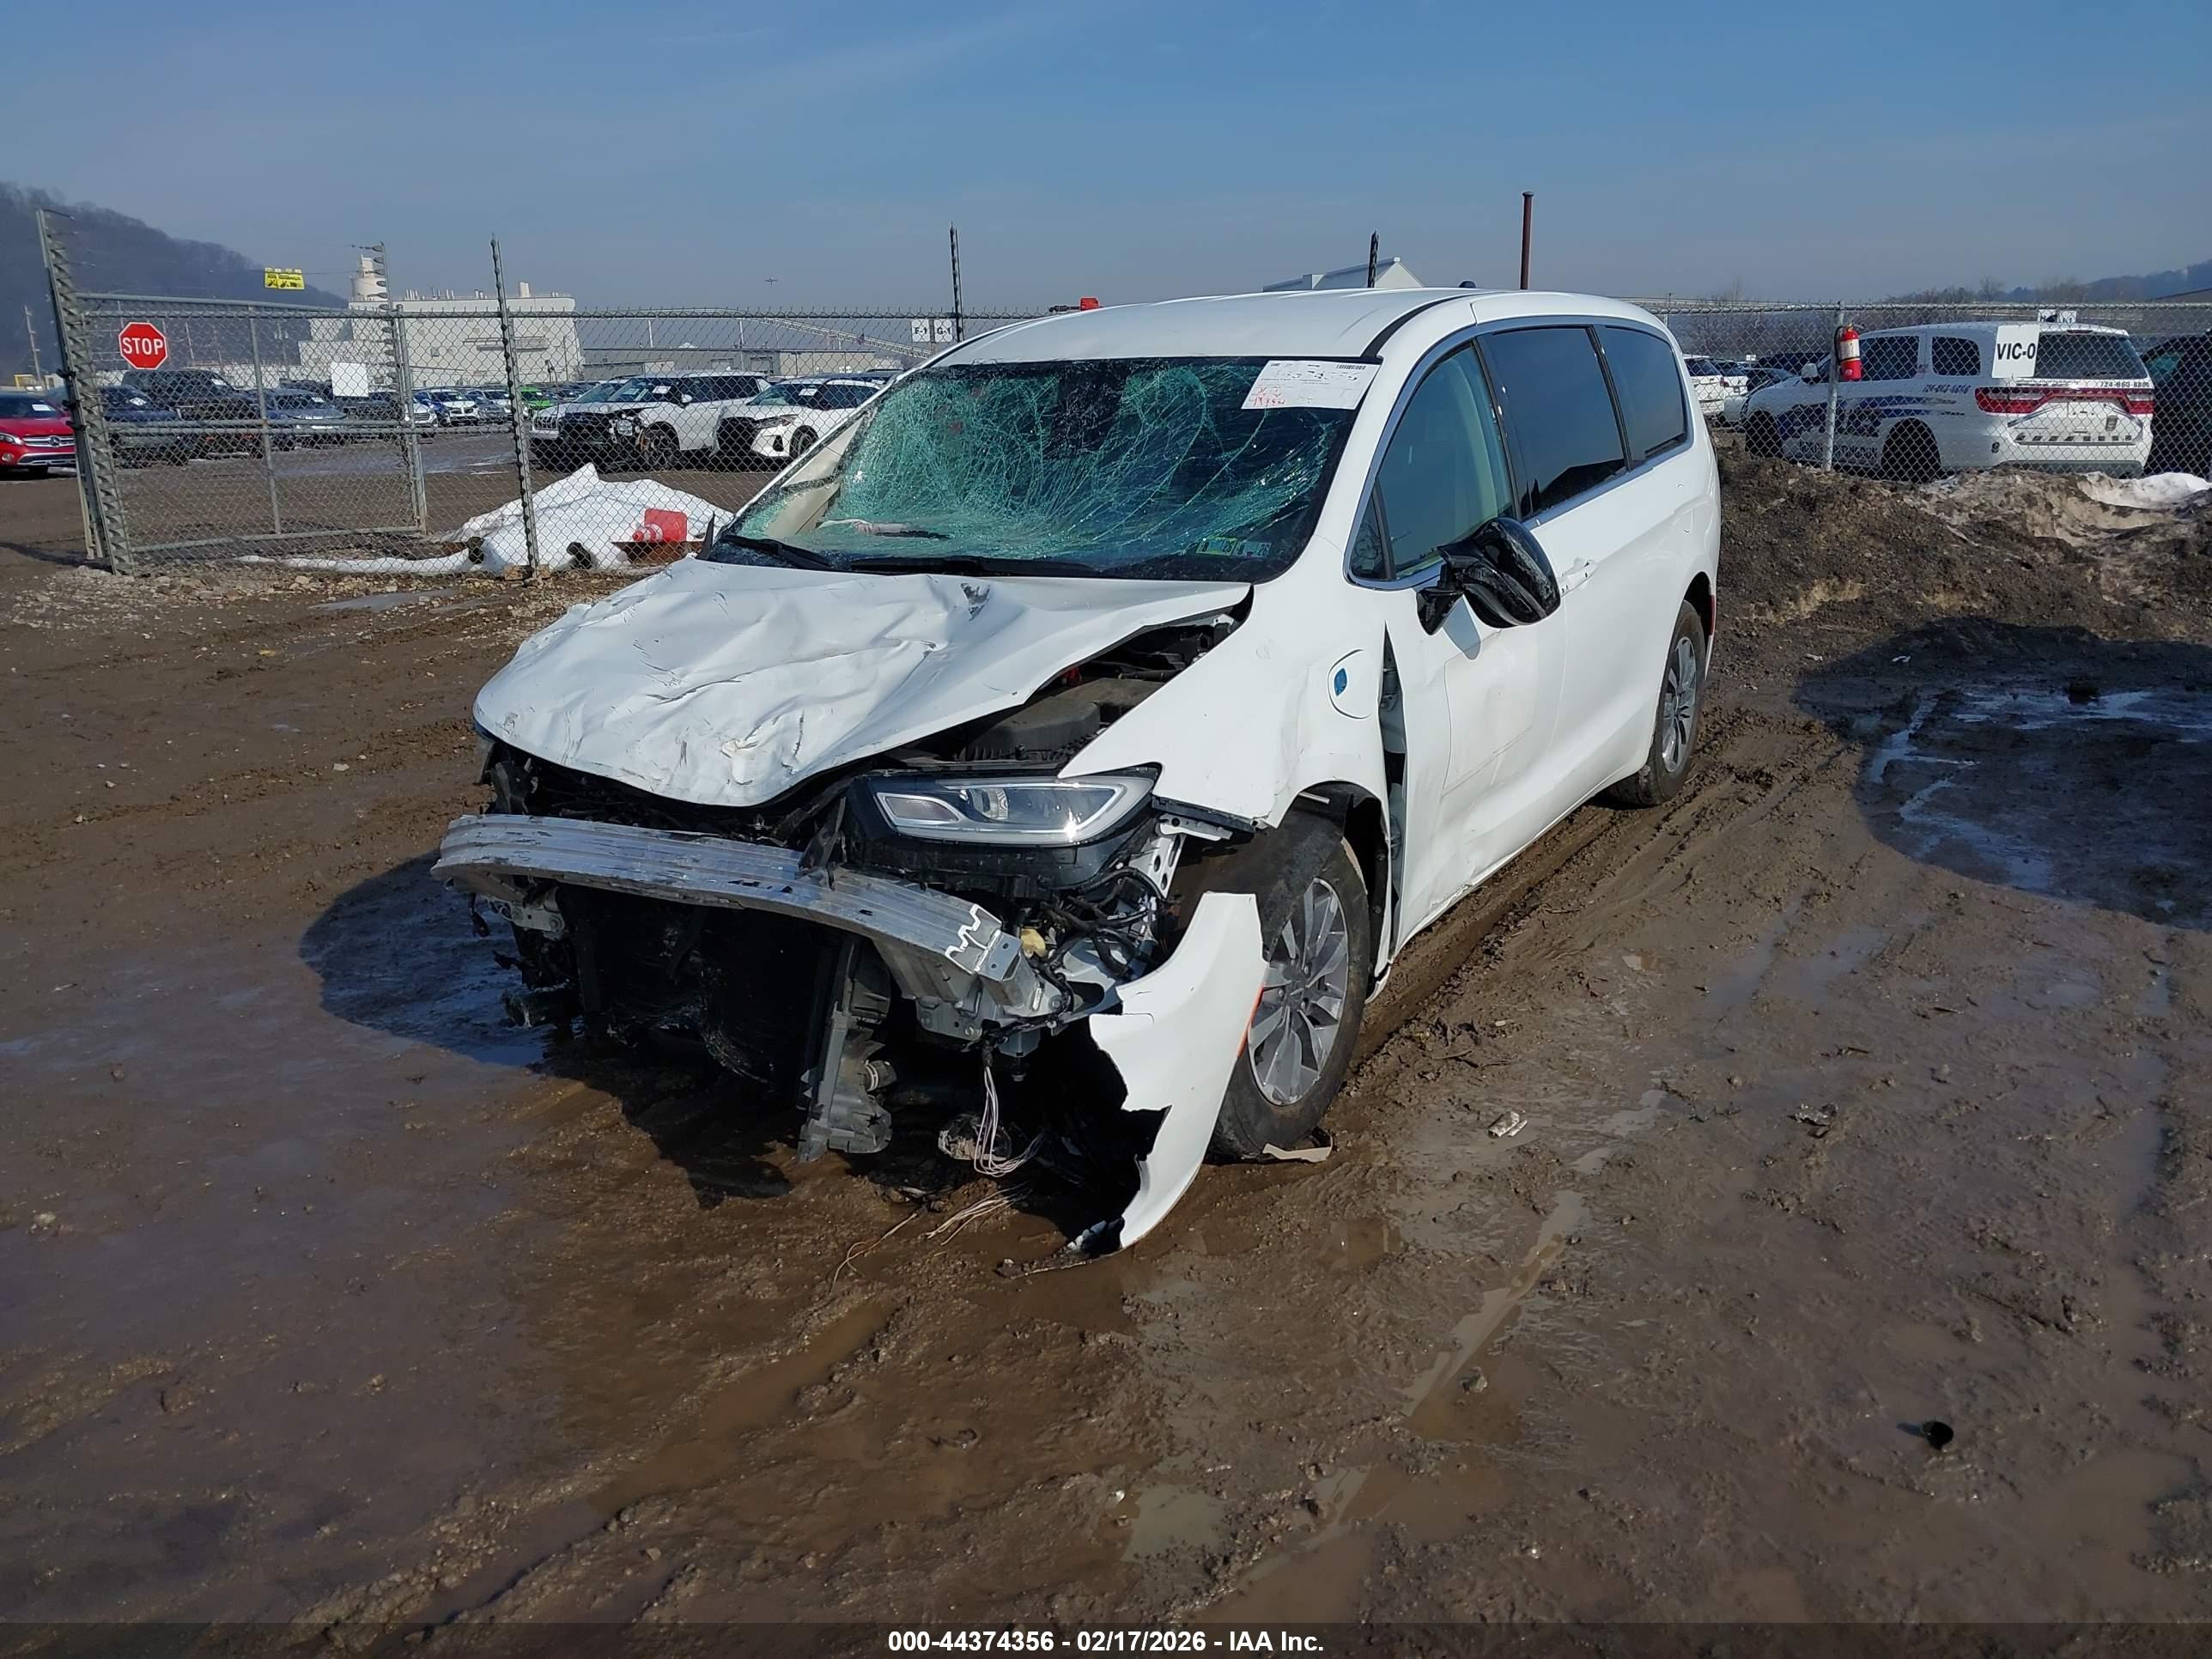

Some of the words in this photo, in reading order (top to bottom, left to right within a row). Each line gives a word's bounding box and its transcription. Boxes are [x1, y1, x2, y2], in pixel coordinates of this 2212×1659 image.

[915, 326, 927, 335] F-1
[937, 326, 951, 335] G-1
[122, 337, 163, 355] STOP
